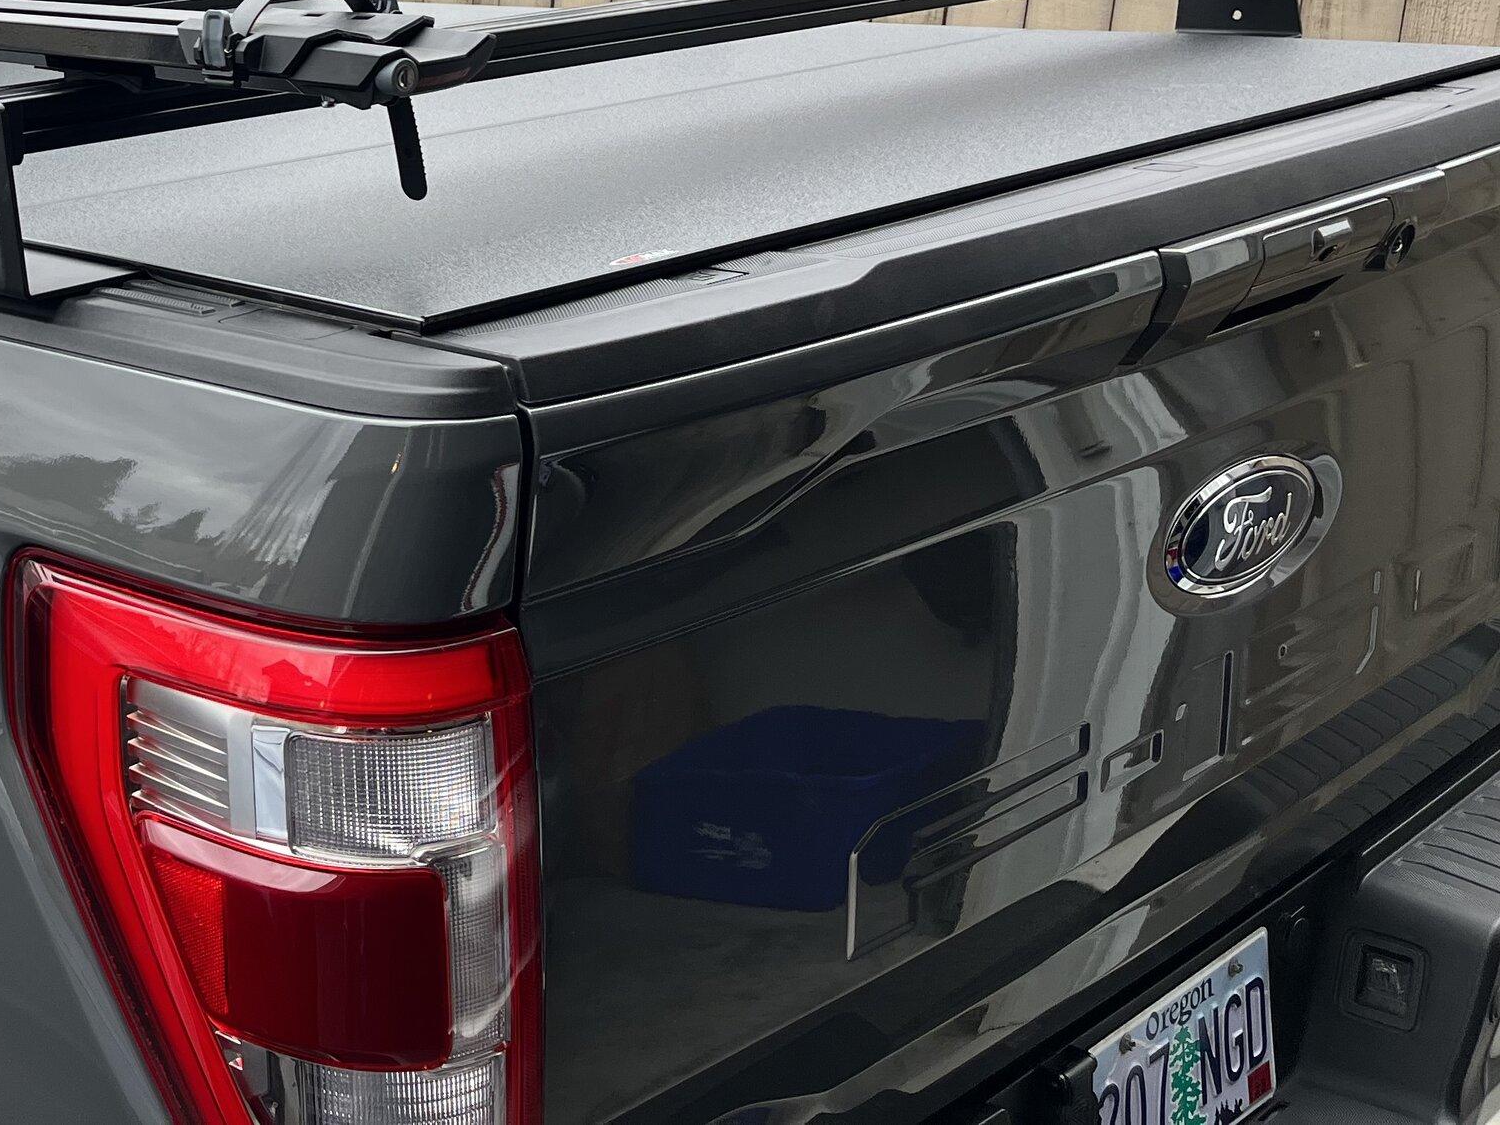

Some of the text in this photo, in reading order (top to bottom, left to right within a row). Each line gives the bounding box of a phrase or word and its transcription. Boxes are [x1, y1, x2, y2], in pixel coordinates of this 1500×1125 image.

[1214, 486, 1293, 572] Ford
[1145, 977, 1215, 1041] Oregon
[1197, 976, 1268, 1106] NGD
